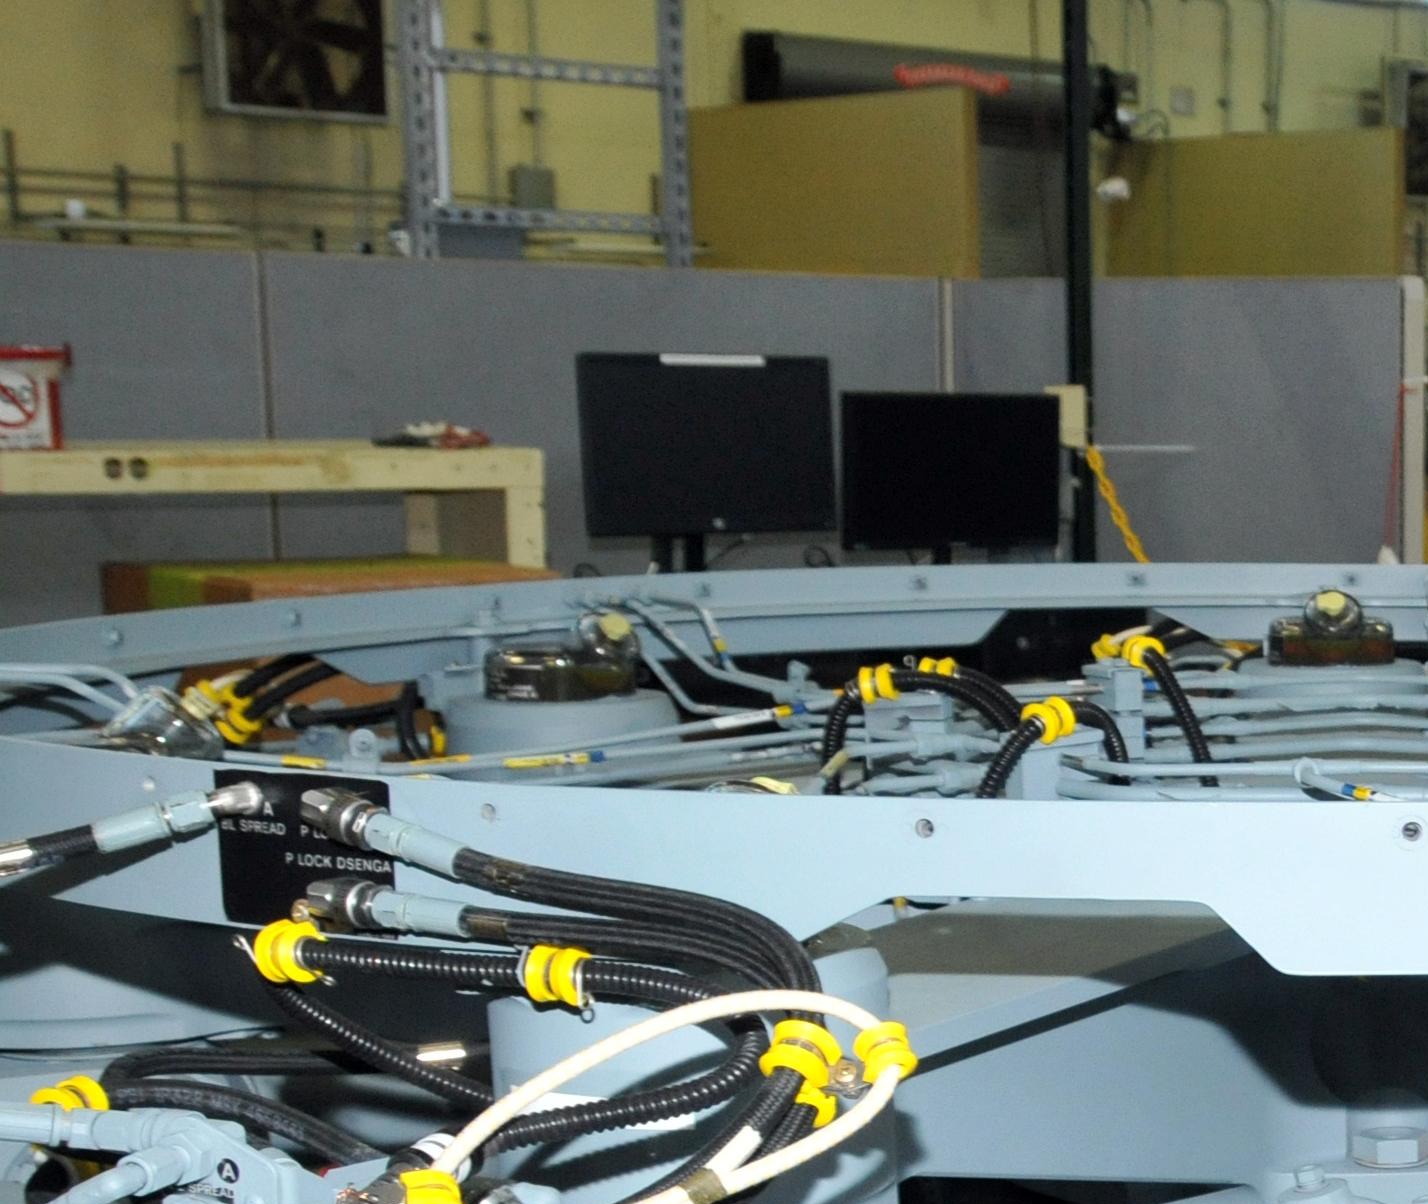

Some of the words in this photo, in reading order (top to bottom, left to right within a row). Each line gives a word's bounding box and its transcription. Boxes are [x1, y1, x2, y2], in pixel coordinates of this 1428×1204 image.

[239, 820, 286, 835] SPREAD
[298, 854, 332, 868] LOCK
[337, 857, 392, 873] DSENGA
